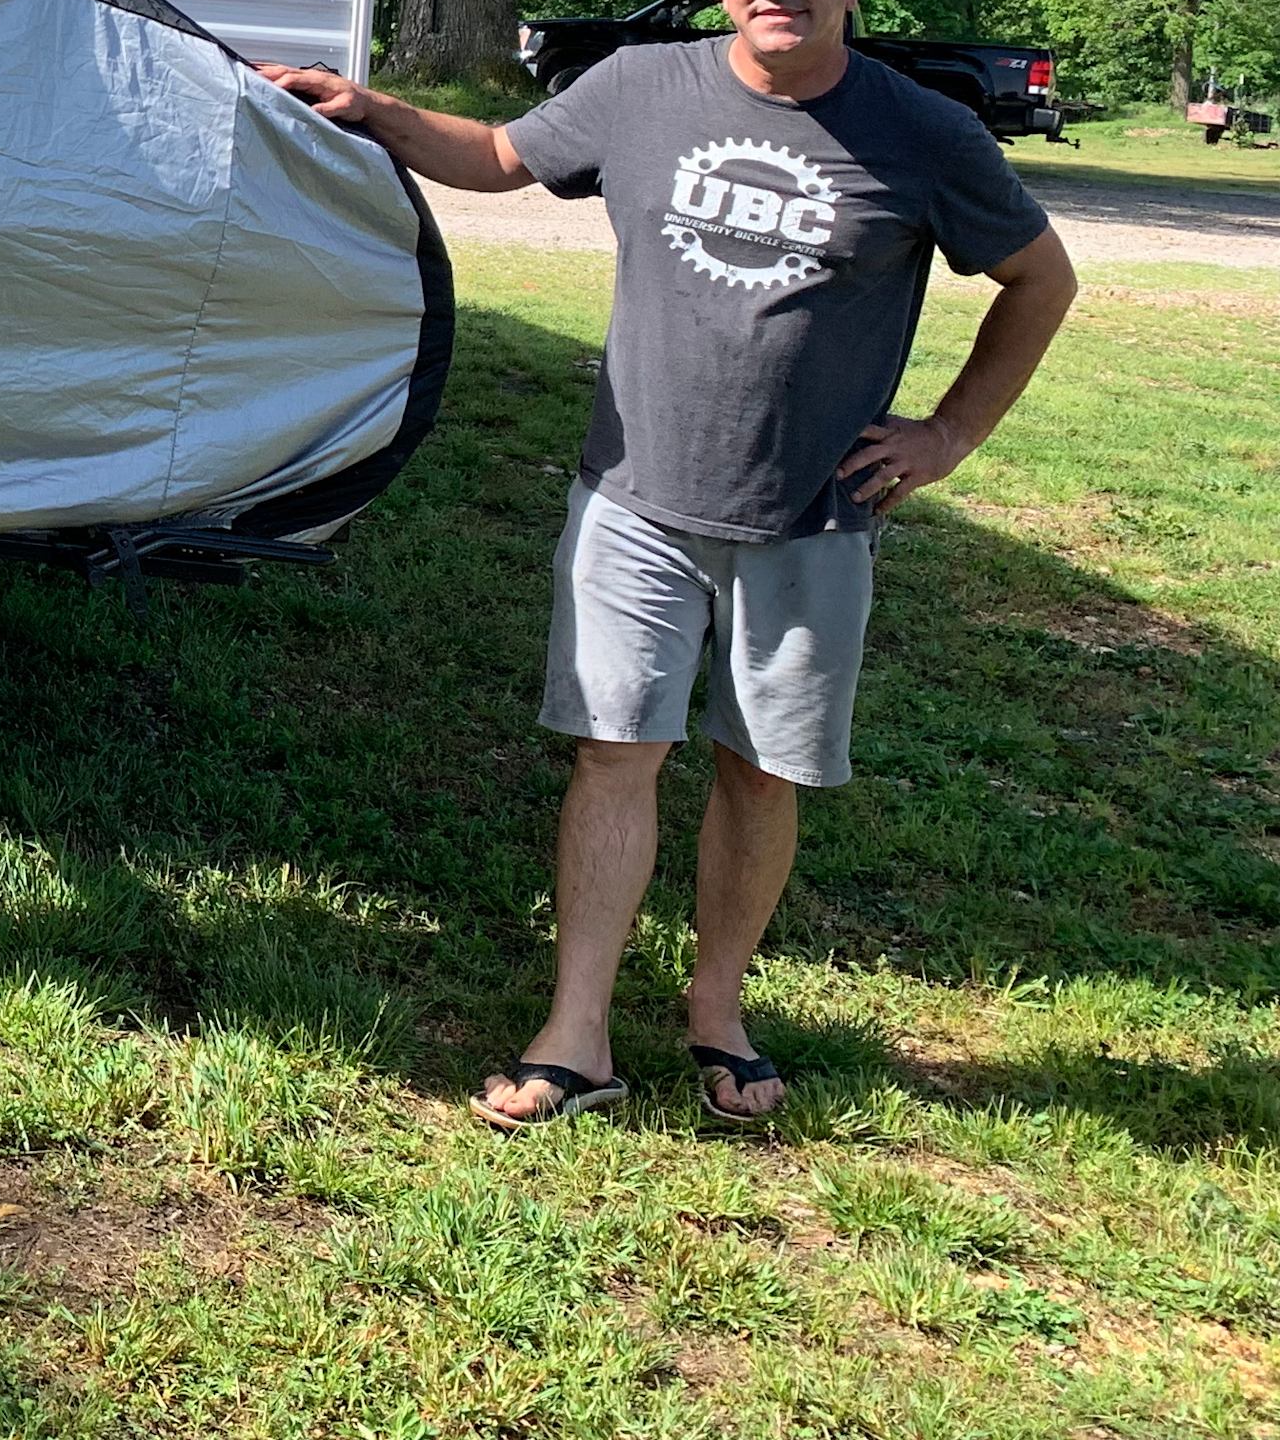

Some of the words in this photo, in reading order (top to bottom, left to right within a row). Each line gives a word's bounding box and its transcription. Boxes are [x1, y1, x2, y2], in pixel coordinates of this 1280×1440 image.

[663, 212, 734, 236] UNIVERSITY
[734, 230, 781, 248] BICYCLE
[782, 240, 827, 258] CENTER
[670, 169, 836, 245] UBC
